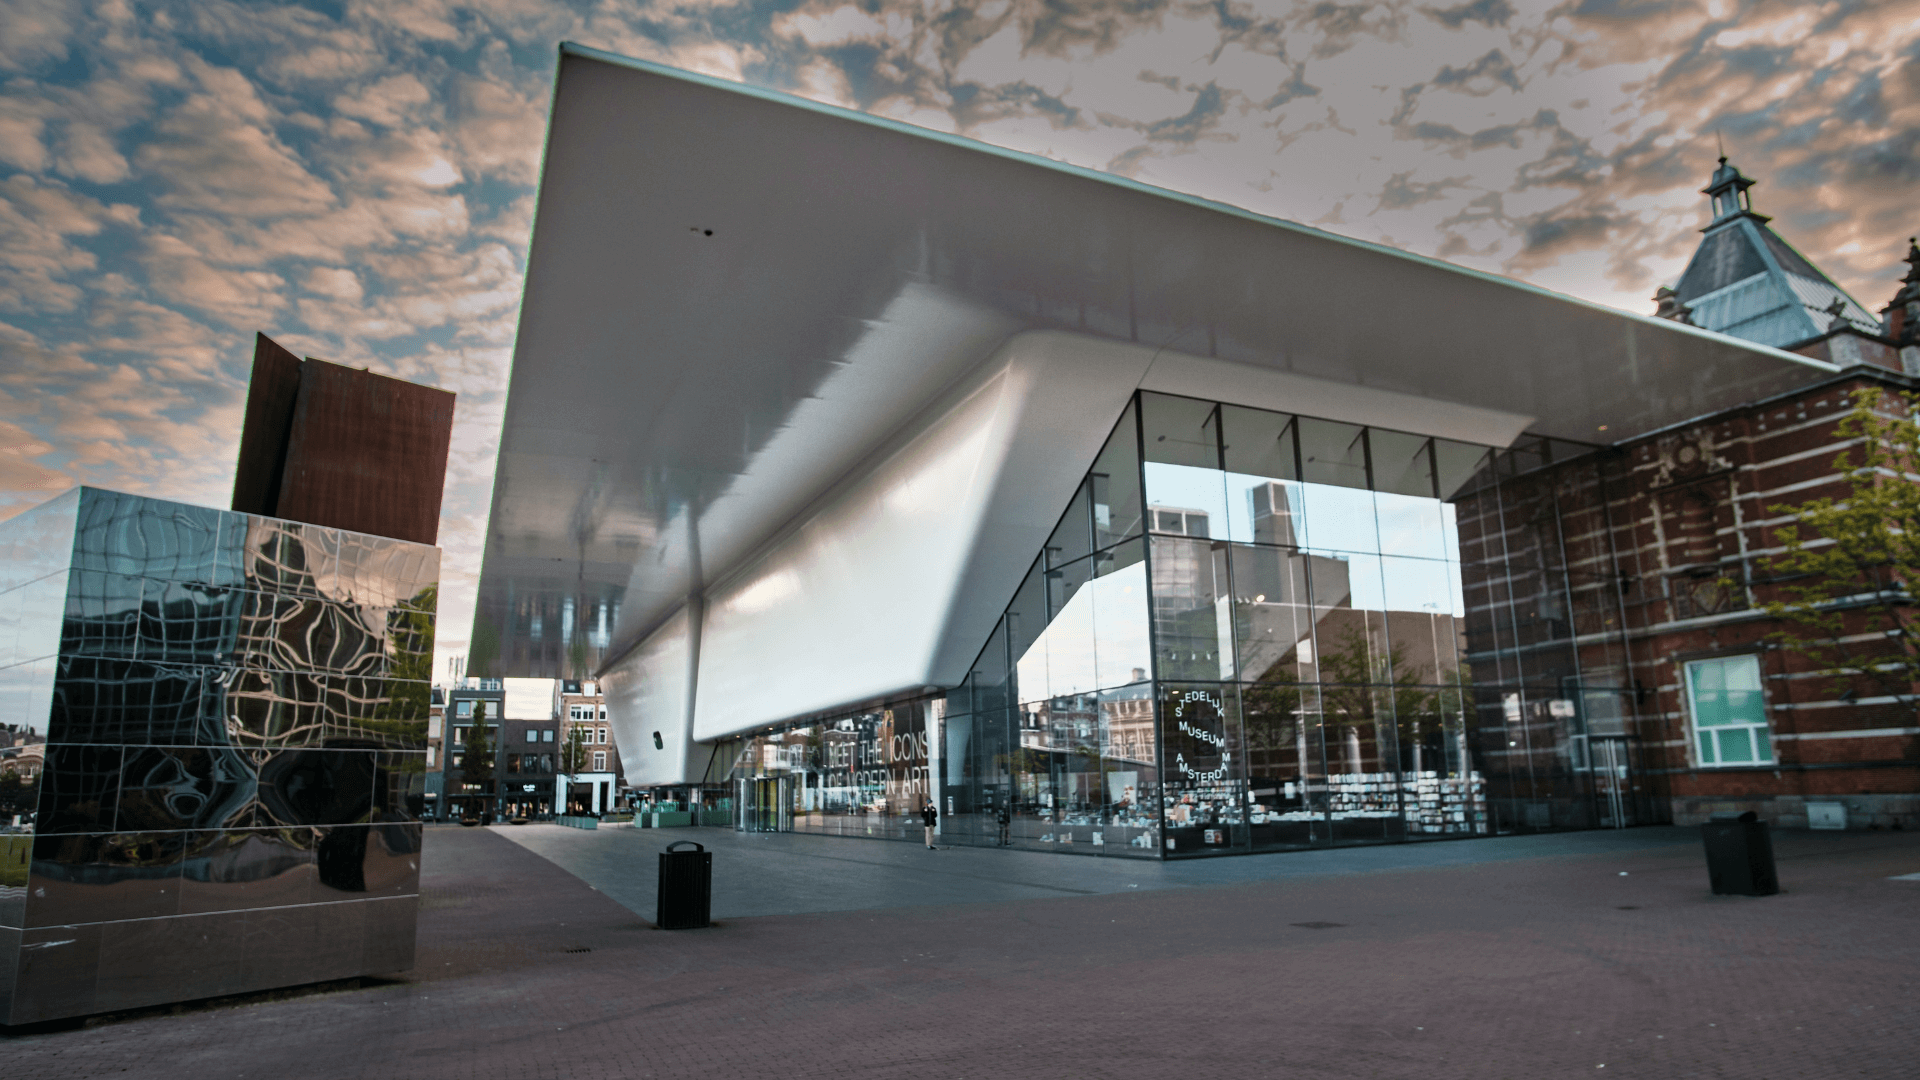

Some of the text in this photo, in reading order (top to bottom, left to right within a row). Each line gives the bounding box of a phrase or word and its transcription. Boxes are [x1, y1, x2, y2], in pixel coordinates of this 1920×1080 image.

[1175, 691, 1225, 717] STEDELIJK
[828, 731, 928, 767] MEET THE ICONS
[1179, 721, 1225, 747] MUSEUM
[828, 766, 930, 796] OF MODERN ART
[1176, 752, 1230, 782] AMSTERDAM
